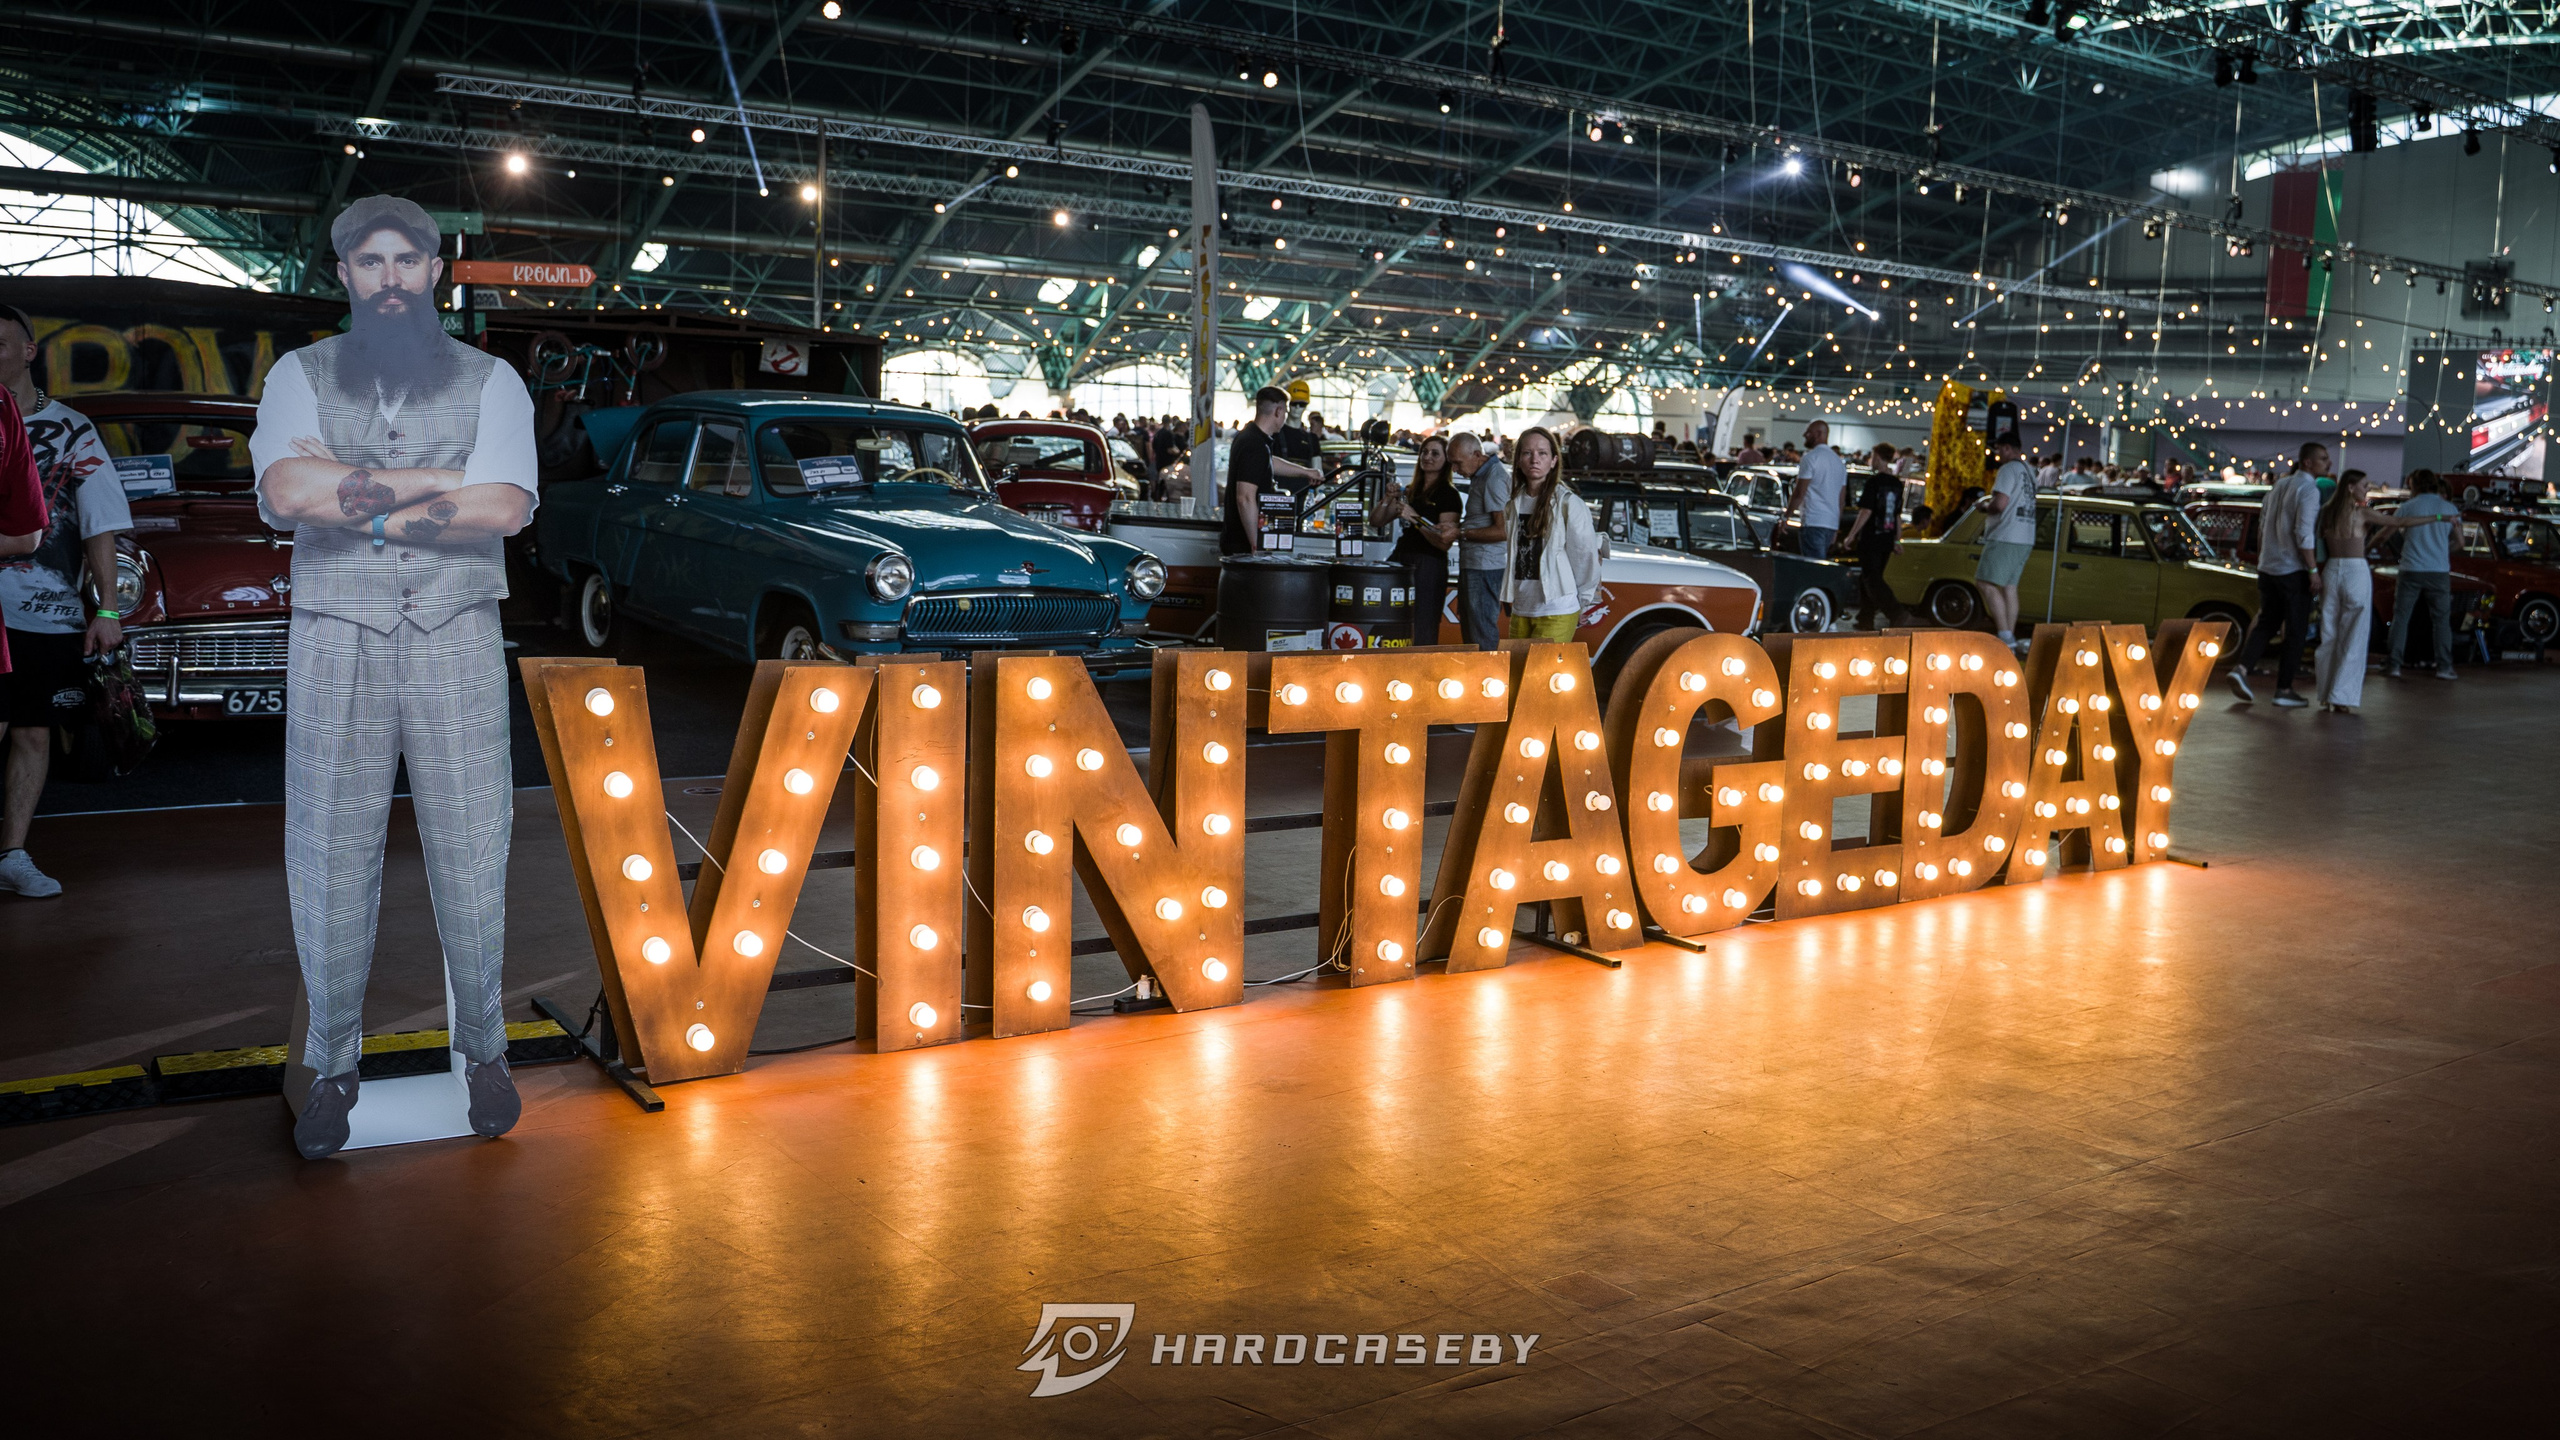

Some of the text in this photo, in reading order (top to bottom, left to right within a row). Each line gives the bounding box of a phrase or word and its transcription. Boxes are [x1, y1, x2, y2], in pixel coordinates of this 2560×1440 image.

[513, 265, 570, 283] KROWN
[30, 591, 66, 602] MEANT
[18, 601, 80, 616] TO BE FREE
[520, 620, 2230, 1084] VINTAGEDAY
